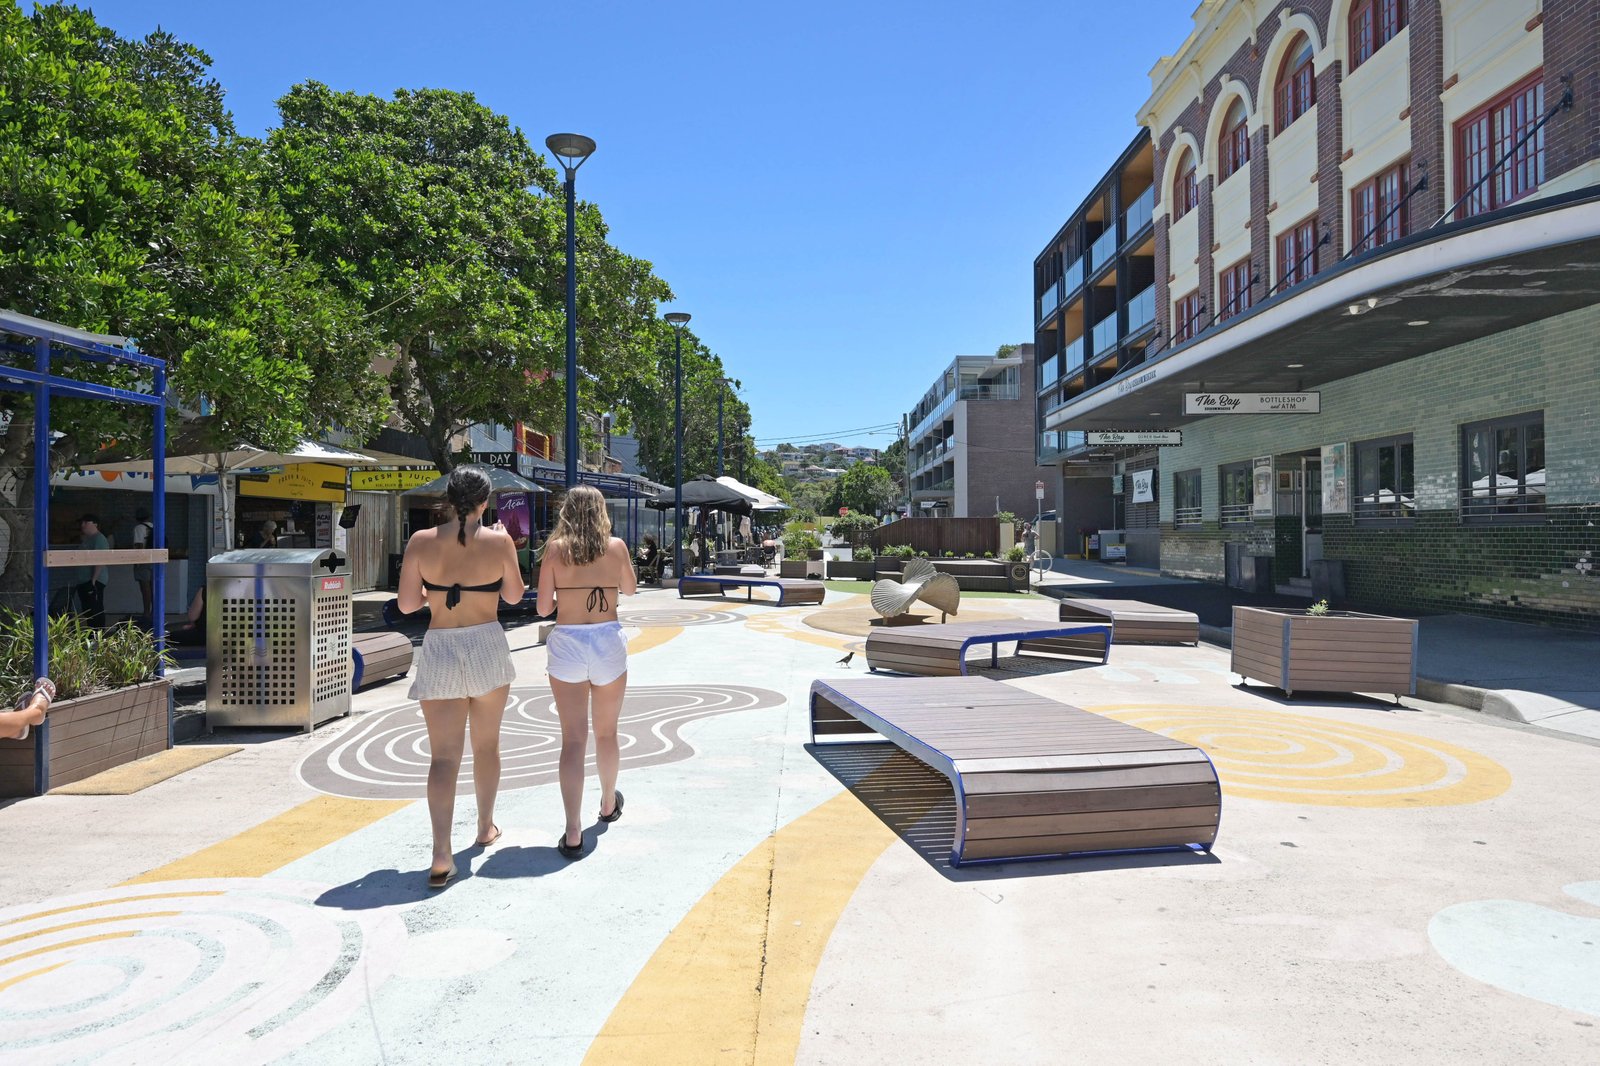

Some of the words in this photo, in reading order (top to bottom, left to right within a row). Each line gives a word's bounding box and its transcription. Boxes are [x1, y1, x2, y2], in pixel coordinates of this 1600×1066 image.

[1195, 394, 1216, 407] The
[1219, 395, 1240, 409] Bay
[1259, 396, 1307, 404] BOTTLESHOP
[1099, 433, 1111, 441] The
[1112, 433, 1125, 443] Bay
[490, 453, 511, 463] DAY
[361, 472, 392, 485] FRESH
[408, 473, 433, 482] JUIC
[324, 580, 342, 589] Rubbish
